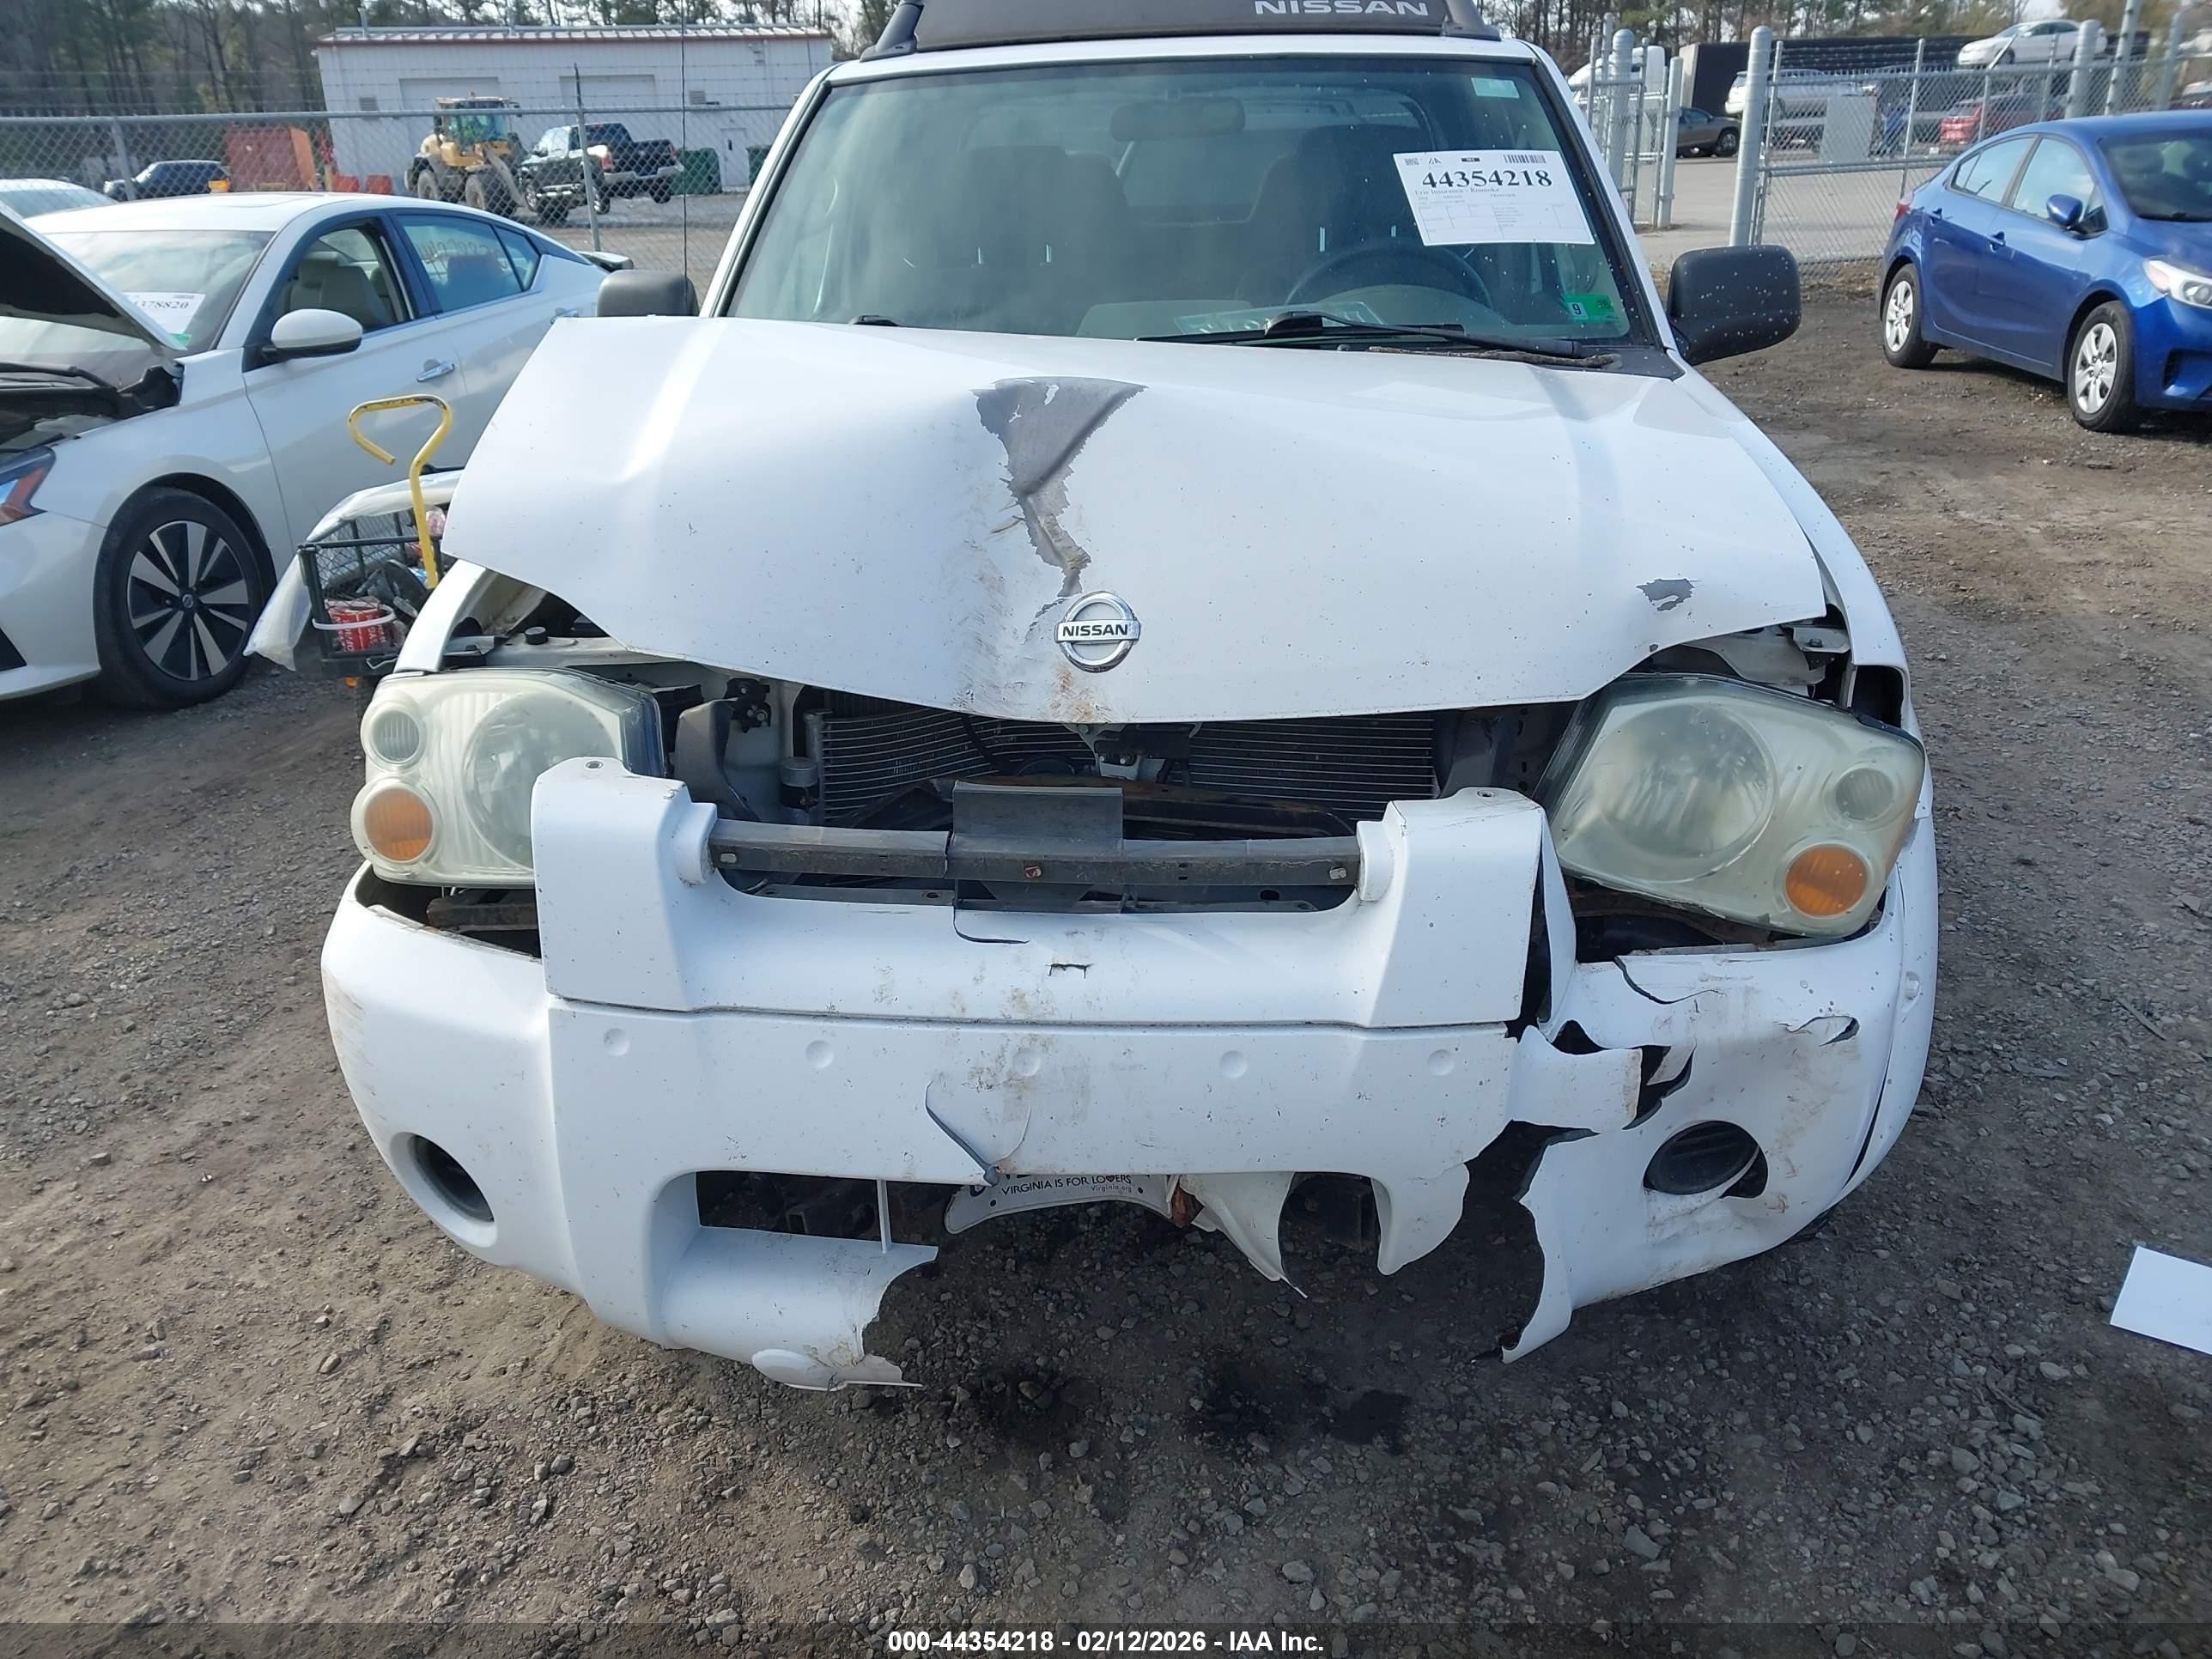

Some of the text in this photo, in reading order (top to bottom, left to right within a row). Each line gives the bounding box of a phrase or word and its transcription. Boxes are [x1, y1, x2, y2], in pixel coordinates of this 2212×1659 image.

[1255, 0, 1429, 16] NISSAN
[1422, 169, 1553, 188] 44354218
[1572, 303, 1582, 315] 9
[1062, 624, 1128, 637] NISSAN
[1001, 1182, 1052, 1196] VIRGINIA
[1054, 1179, 1064, 1188] IS
[1066, 1176, 1090, 1188] FOR
[1091, 1185, 1132, 1194] Virginia.org
